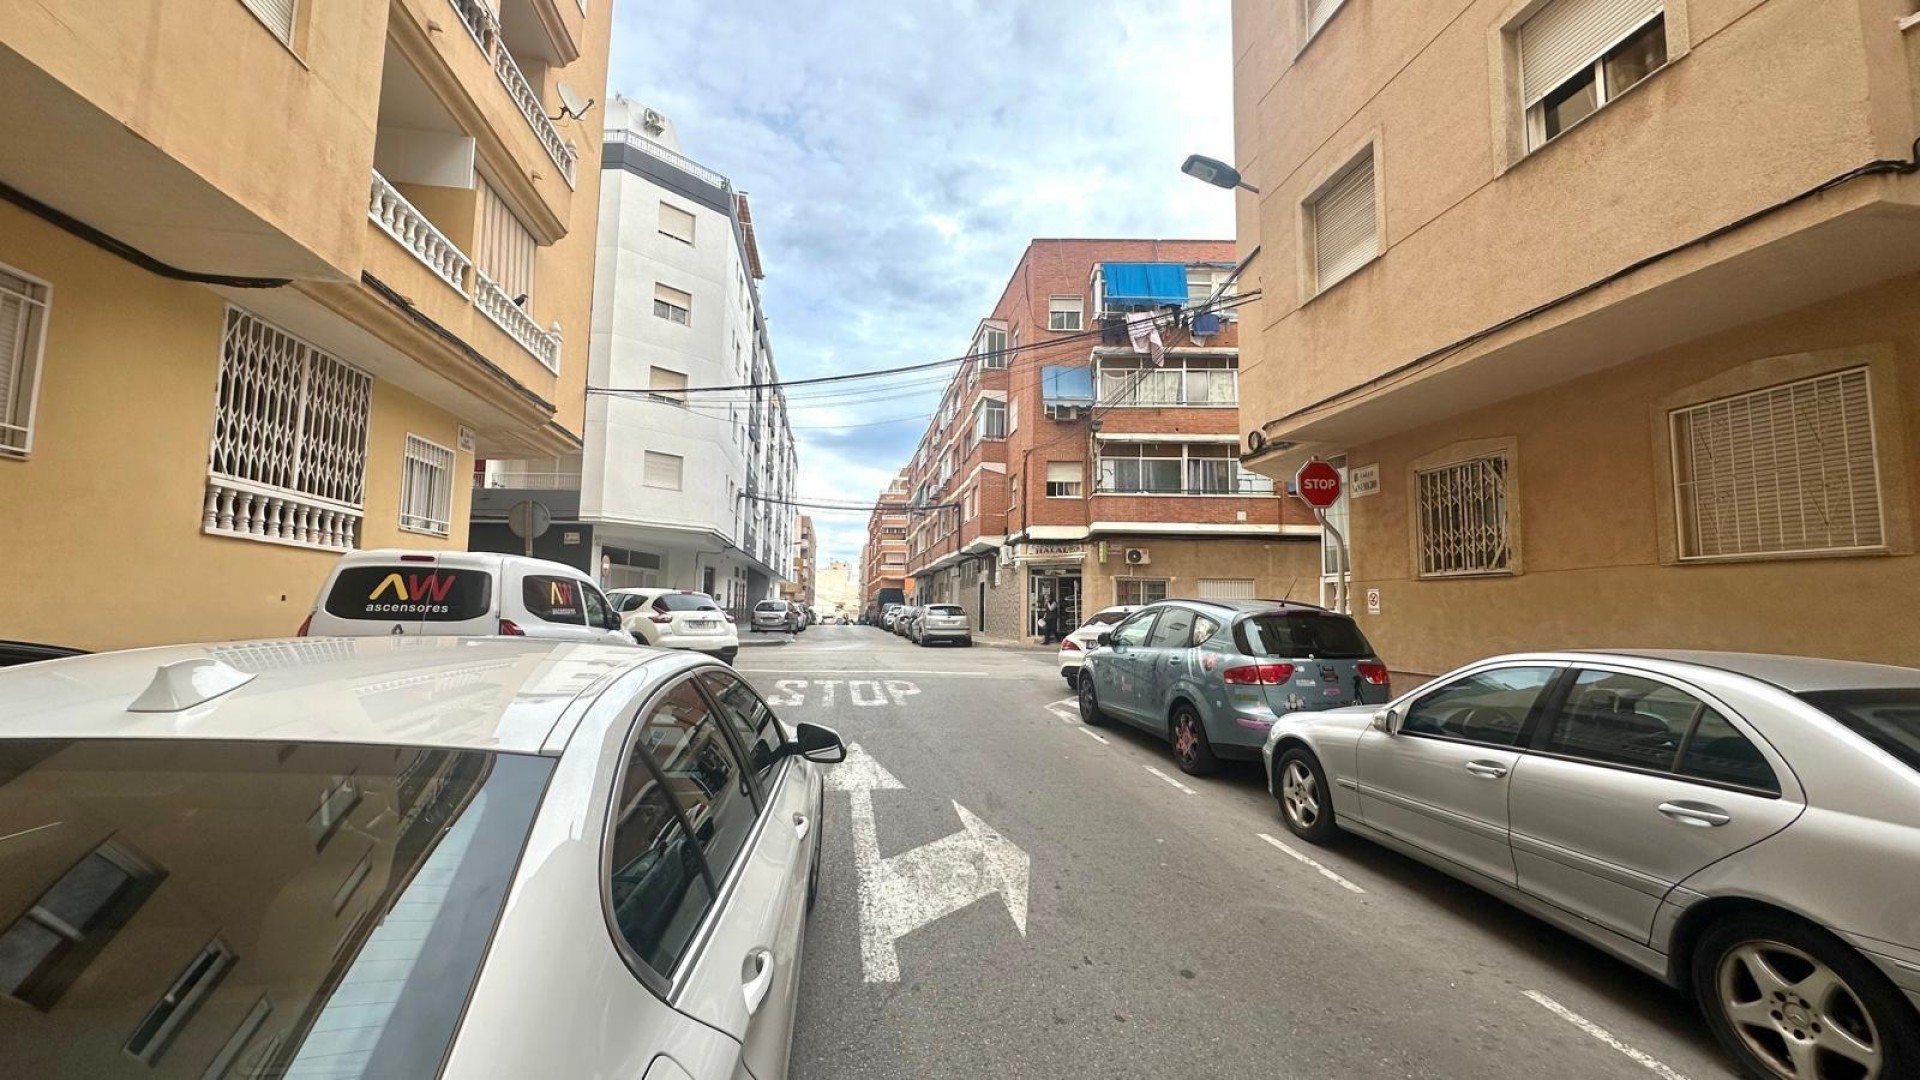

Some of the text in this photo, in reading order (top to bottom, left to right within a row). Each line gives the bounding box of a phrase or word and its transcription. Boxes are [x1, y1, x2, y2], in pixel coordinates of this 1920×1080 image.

[1304, 479, 1336, 489] STOP
[366, 604, 449, 612] ascensores
[767, 679, 922, 707] STOP
